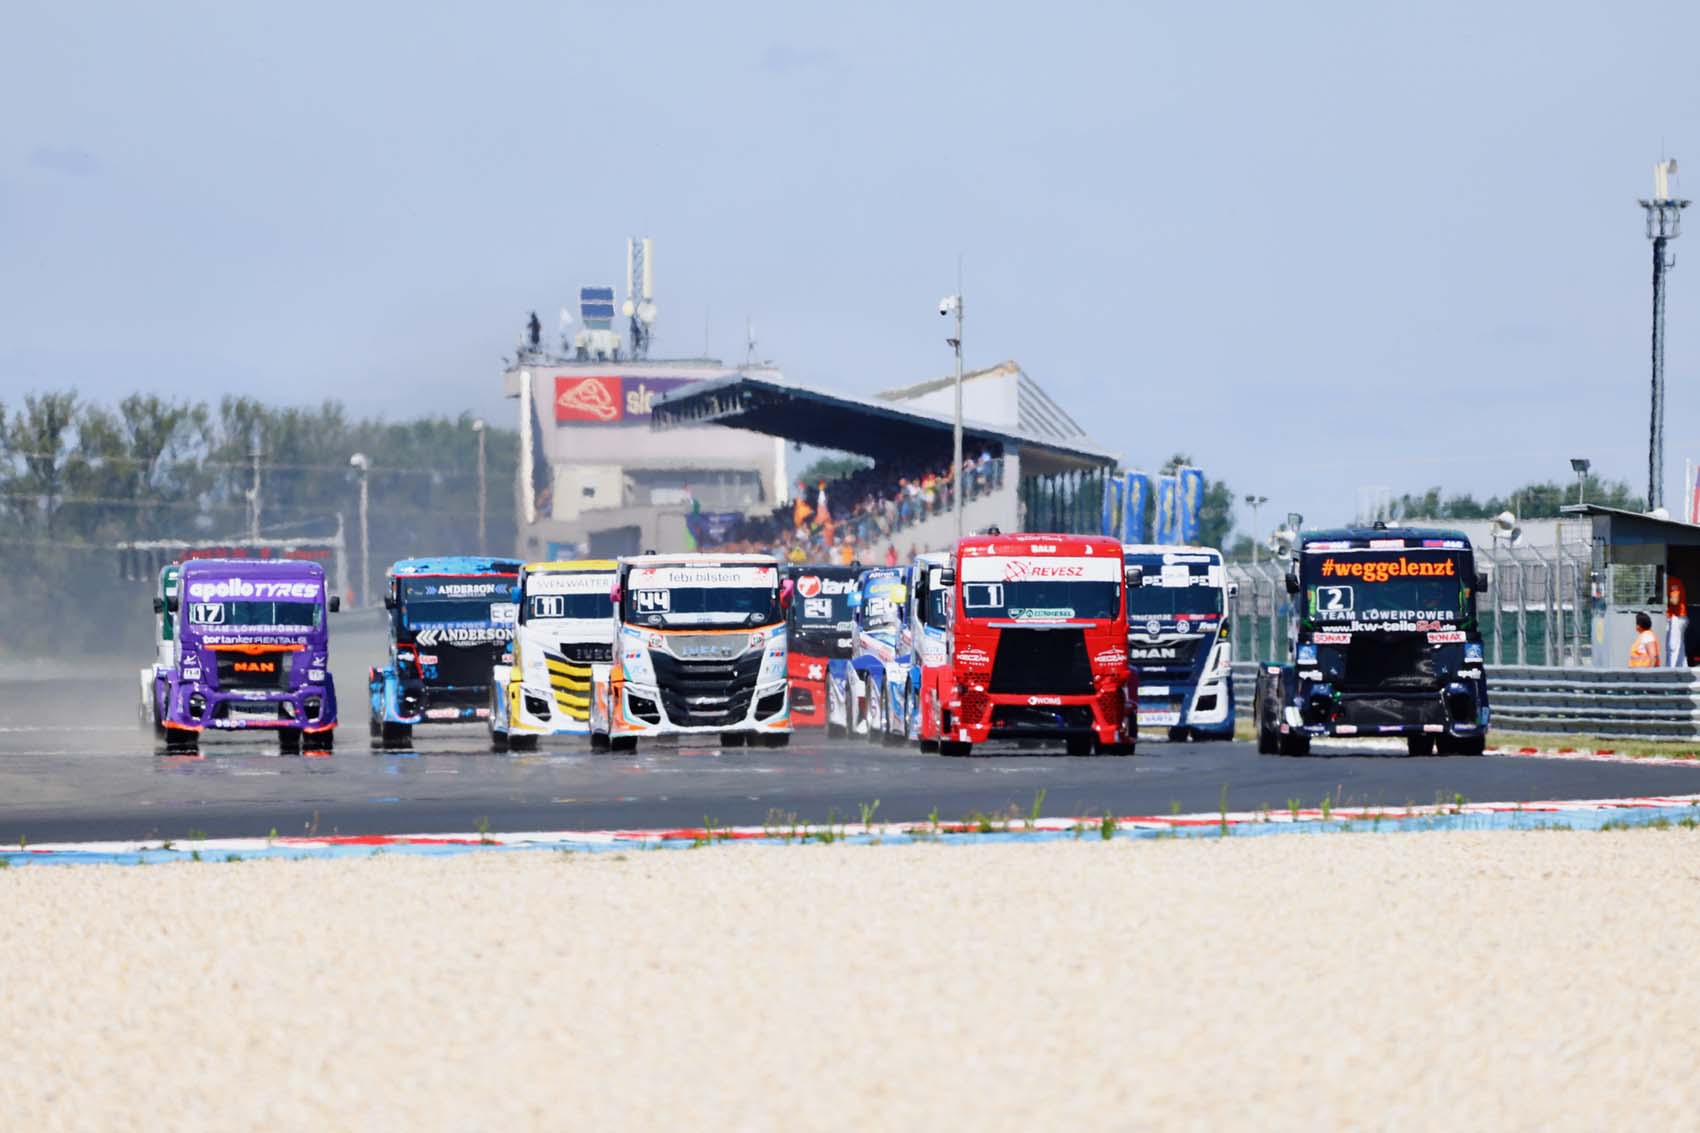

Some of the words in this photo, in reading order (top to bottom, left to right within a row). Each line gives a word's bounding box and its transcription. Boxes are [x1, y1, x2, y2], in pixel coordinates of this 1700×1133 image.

[669, 572, 693, 583] febi
[695, 572, 741, 583] bilstein
[1322, 557, 1455, 582] #weggelenzt
[189, 578, 254, 602] apollo
[254, 583, 320, 598] TYRES
[438, 584, 495, 594] ANDERSON
[988, 585, 998, 606] 1
[541, 597, 557, 615] 11
[639, 593, 668, 610] 44
[1327, 588, 1345, 610] 2
[197, 604, 220, 623] 17
[805, 599, 832, 618] 24
[1321, 610, 1357, 620] TEAM
[438, 628, 514, 641] ANDERSON
[1131, 648, 1176, 659] MAN
[233, 661, 275, 672] MAN
